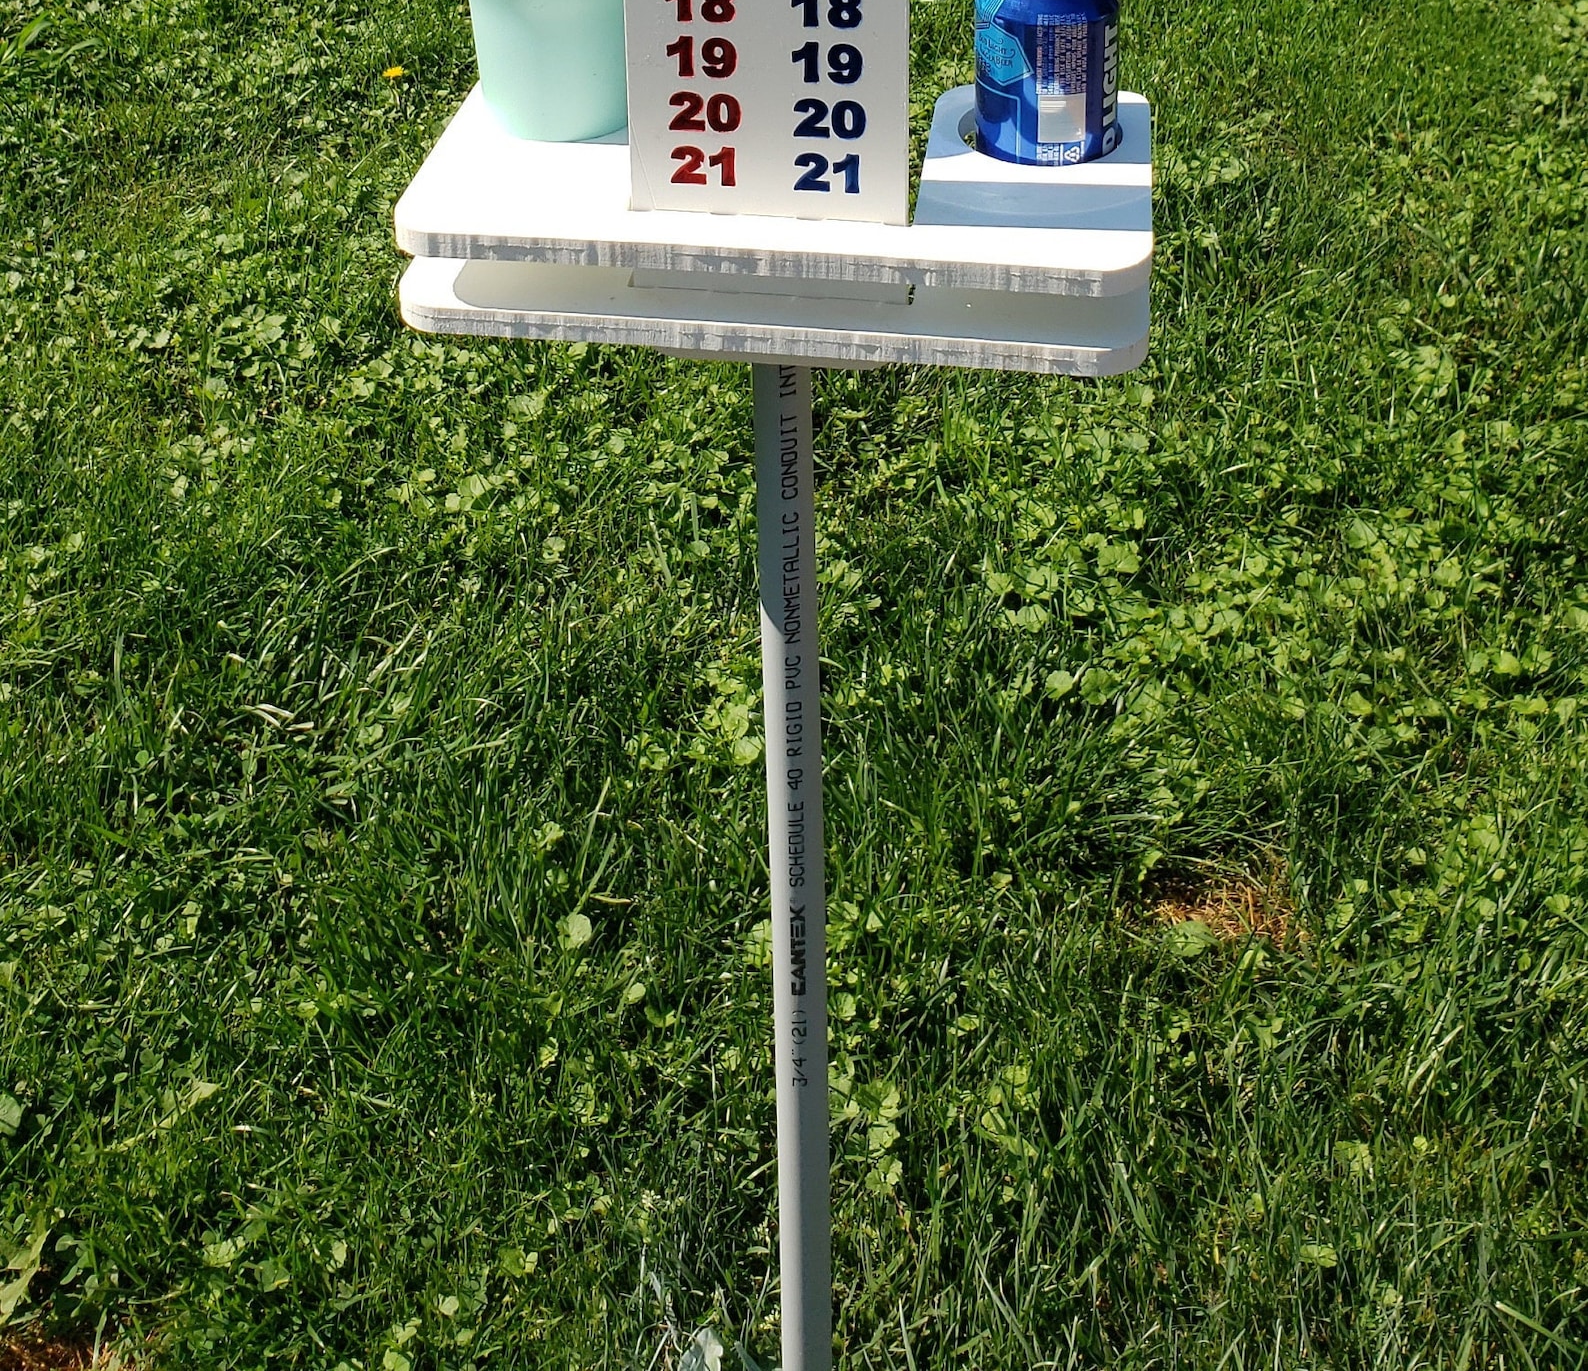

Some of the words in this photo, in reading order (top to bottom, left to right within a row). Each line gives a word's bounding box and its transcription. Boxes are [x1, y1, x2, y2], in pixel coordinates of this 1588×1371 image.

[667, 36, 738, 78] 19
[792, 42, 862, 86] 19
[1103, 24, 1118, 127] LIGHT
[669, 90, 743, 133] 20
[794, 99, 867, 140] 20
[671, 144, 736, 187] 21
[794, 153, 859, 194] 21
[780, 414, 799, 501] CONDUIT
[782, 511, 801, 645] NONMETALLIC
[784, 656, 801, 690] PVC
[786, 701, 803, 758] RIGID
[787, 768, 803, 791] 40
[788, 801, 805, 887] SCHEDULE
